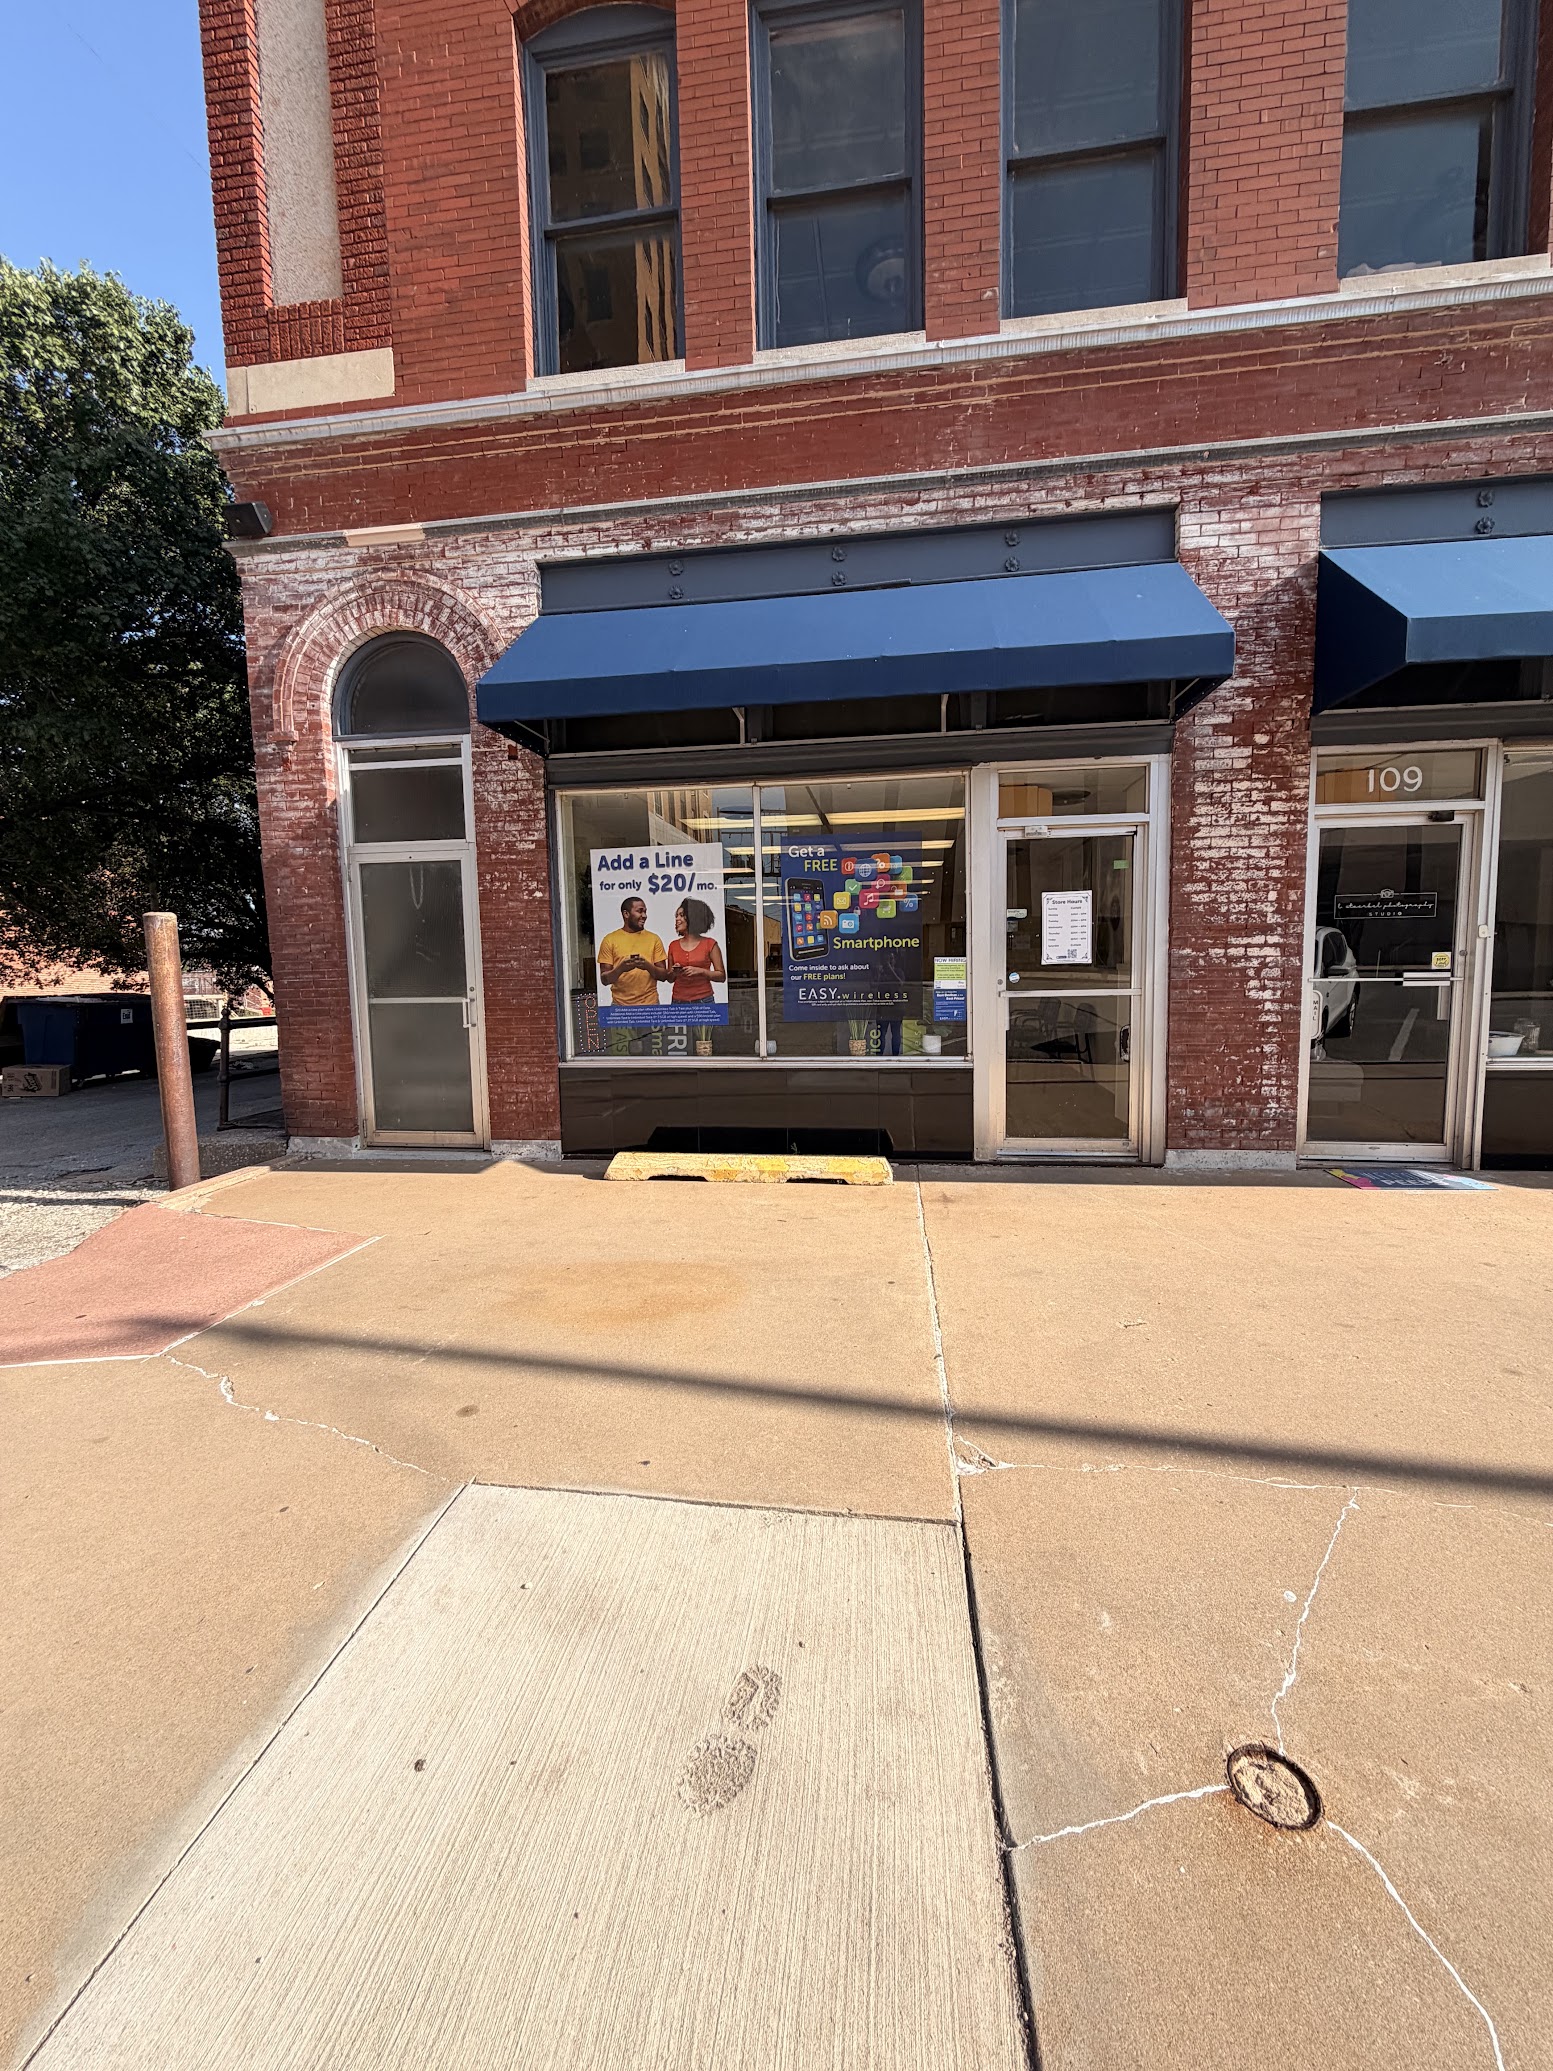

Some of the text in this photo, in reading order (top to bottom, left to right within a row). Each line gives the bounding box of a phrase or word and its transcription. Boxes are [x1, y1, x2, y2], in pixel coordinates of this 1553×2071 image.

[1368, 766, 1422, 793] 109
[788, 845, 825, 857] Get a
[597, 852, 694, 871] Add a Line
[804, 859, 838, 872] FREE
[600, 881, 616, 890] for
[618, 880, 642, 891] only
[1382, 901, 1434, 910] photography
[833, 936, 920, 951] Smartphone
[824, 973, 846, 981] plans!
[867, 1024, 881, 1055] ice.
